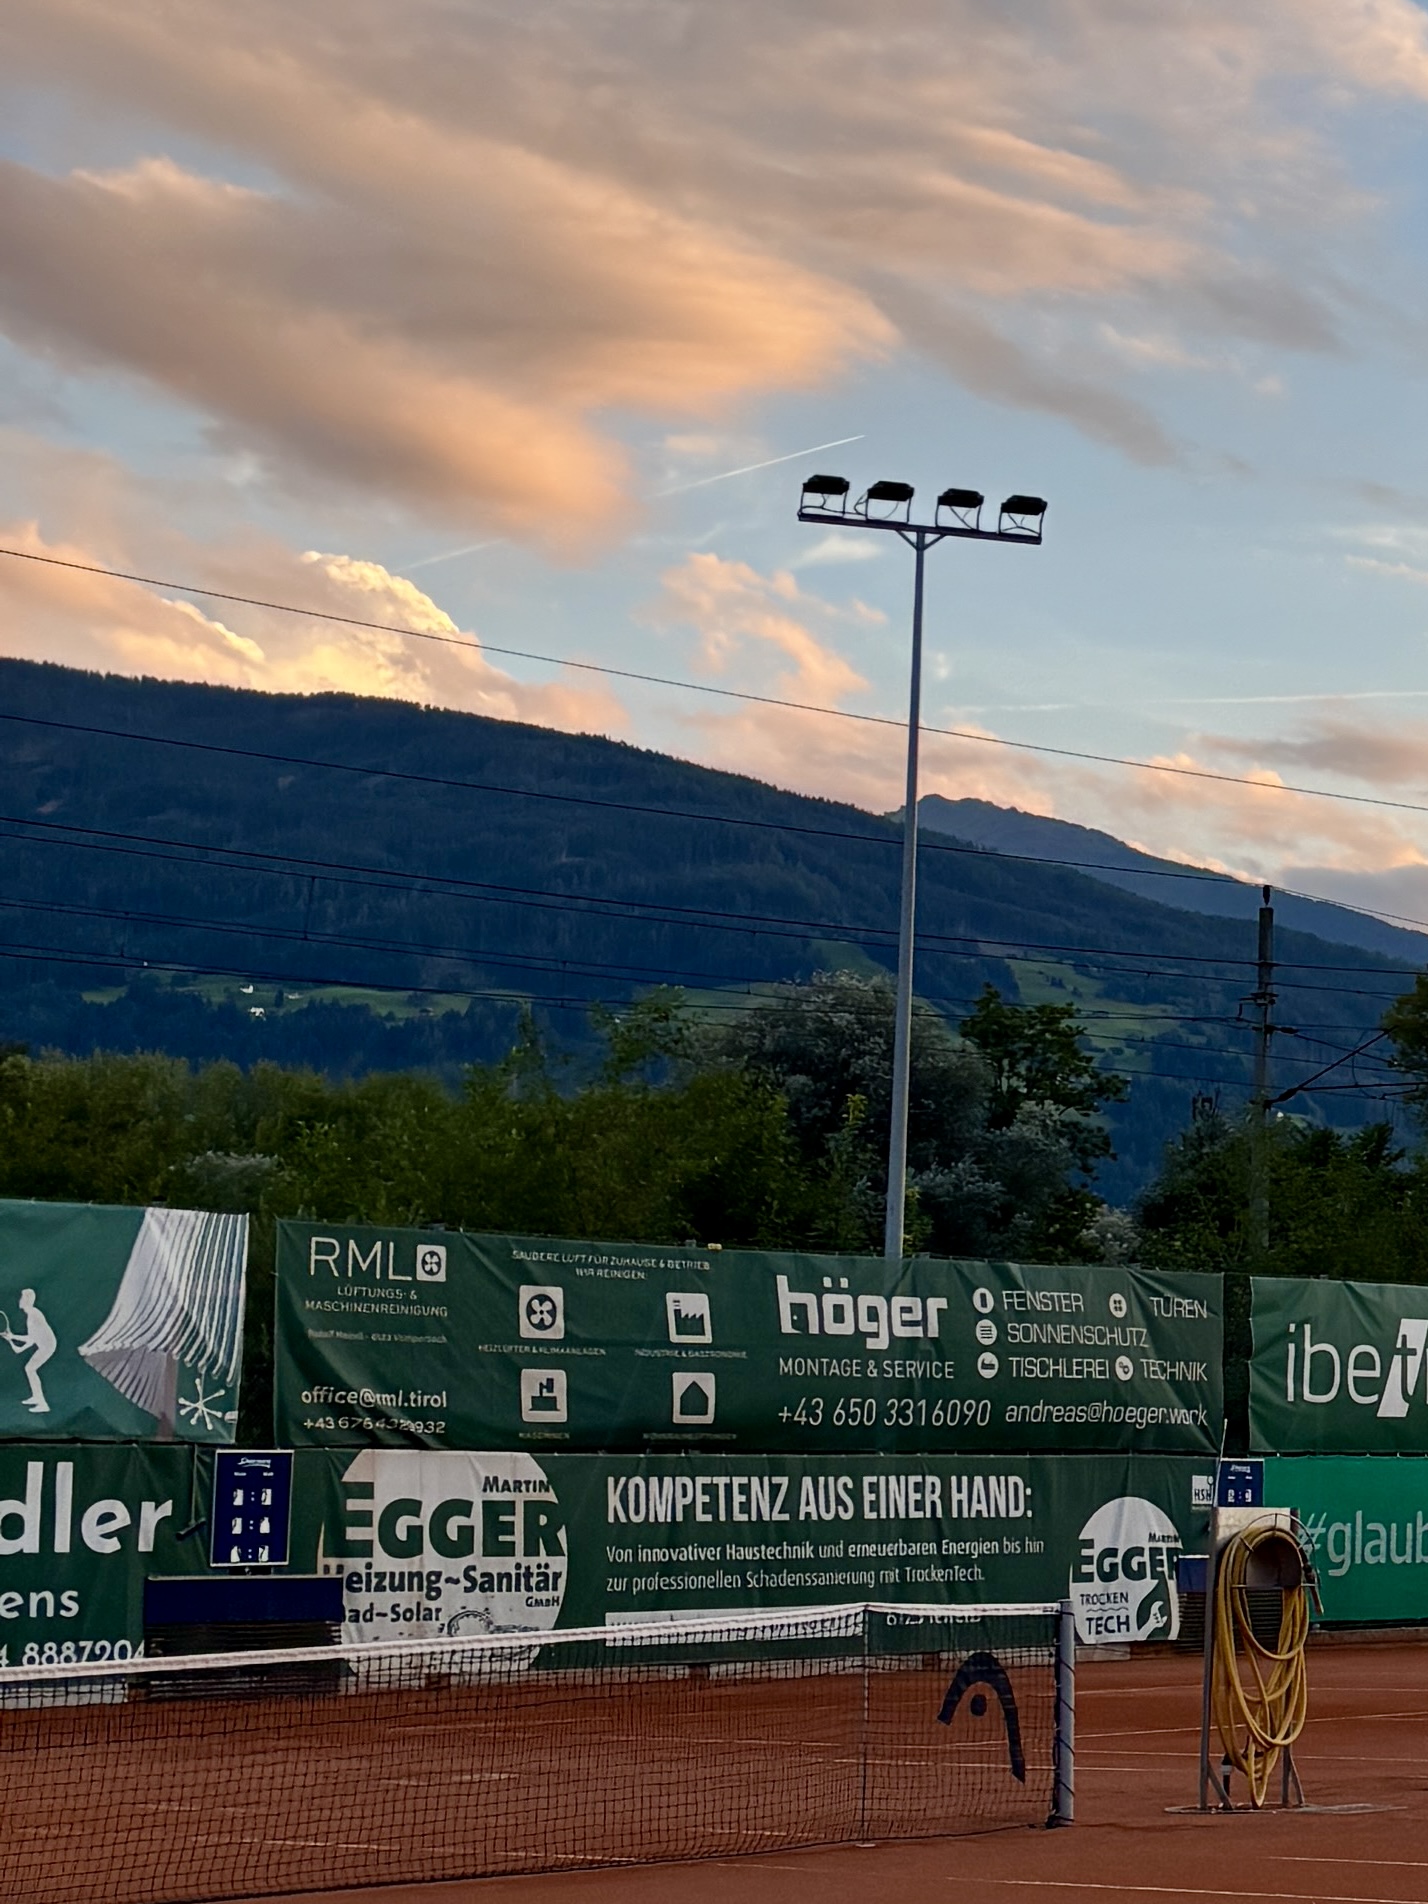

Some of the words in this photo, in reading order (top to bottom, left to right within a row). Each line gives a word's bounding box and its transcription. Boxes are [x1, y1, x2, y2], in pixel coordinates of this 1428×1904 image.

[310, 1236, 412, 1281] RML
[304, 1299, 448, 1318] MASCHINENREINIGUNG
[775, 1274, 949, 1350] höger
[1002, 1290, 1085, 1313] FENSTER
[1149, 1293, 1207, 1319] TÜREN
[1007, 1322, 1149, 1348] SONNENSCHUTZ
[778, 1357, 861, 1377] MONTAGE
[866, 1359, 878, 1377] &
[882, 1360, 955, 1380] SERVICE
[1007, 1356, 1109, 1380] TISCHLEREI
[1140, 1359, 1208, 1382] TECHNIK
[301, 1385, 448, 1408] office@rml.tirol
[303, 1416, 335, 1430] +43
[777, 1398, 824, 1426] +43
[832, 1398, 876, 1426] 650
[883, 1399, 991, 1427] 3316090
[1005, 1401, 1208, 1431] andreas@hoeger.work
[482, 1475, 550, 1494] MARTIN
[607, 1475, 790, 1523] KOMPETENZ
[798, 1475, 854, 1521] AUS
[862, 1474, 943, 1519] EINER
[950, 1475, 1033, 1519] HAND:
[0, 1460, 173, 1556] dler
[323, 1481, 567, 1560] EGGER
[606, 1545, 633, 1563] Von
[637, 1542, 721, 1562] innovativer
[725, 1541, 815, 1561] Haustechnik
[818, 1540, 844, 1559] und
[848, 1538, 938, 1558] erneuerbaren
[941, 1537, 999, 1559] Energien
[1003, 1536, 1021, 1555] bis
[1024, 1536, 1045, 1554] hin
[606, 1577, 628, 1592] zur
[632, 1569, 742, 1595] professionellen
[746, 1567, 876, 1589] Schadenssanierung
[879, 1566, 900, 1584] mit
[905, 1563, 986, 1583] TrockenTech.
[0, 1590, 80, 1619] ens
[1079, 1591, 1130, 1606] TROCKEN
[1085, 1614, 1131, 1636] TECH
